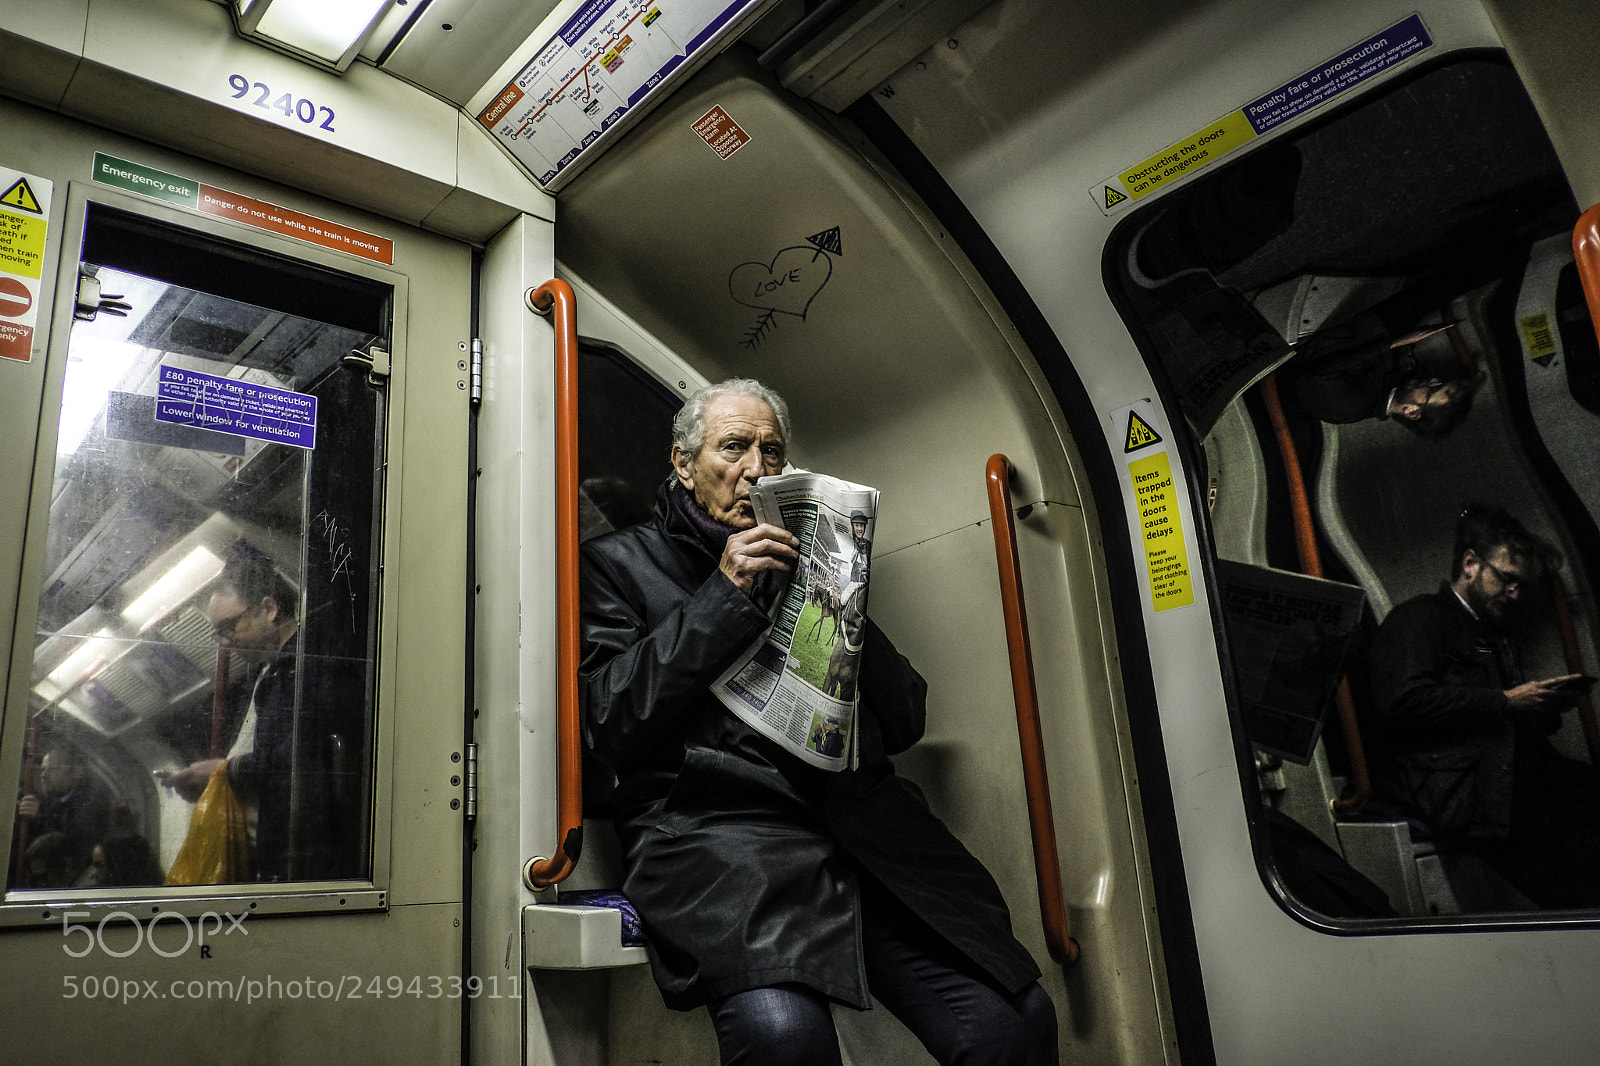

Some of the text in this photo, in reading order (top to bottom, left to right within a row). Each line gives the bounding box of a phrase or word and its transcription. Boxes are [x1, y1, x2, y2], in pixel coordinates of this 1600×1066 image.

[646, 77, 658, 88] Zone
[1248, 36, 1388, 118] Penalty fare or prosecution
[1261, 114, 1272, 123] you
[1272, 108, 1281, 116] fail
[1288, 96, 1304, 108] show
[1312, 80, 1334, 95] demand
[1359, 52, 1386, 70] validated
[1386, 35, 1417, 55] smartcard
[1266, 115, 1281, 126] other
[1281, 106, 1297, 118] travel
[1297, 92, 1324, 110] authority
[1323, 85, 1337, 96] valid
[1337, 80, 1347, 88] for
[1347, 74, 1358, 83] the
[1358, 64, 1376, 78] whole
[1385, 53, 1400, 64] your
[1400, 40, 1424, 56] journey
[228, 74, 336, 132] 92402
[485, 90, 516, 121] Central line
[606, 114, 616, 125] Zone
[695, 111, 718, 132] Passenger
[699, 114, 725, 137] Emergency
[583, 135, 593, 145] Zone
[704, 126, 719, 140] Alarm
[710, 130, 729, 148] Located
[716, 133, 737, 152] Opposite
[720, 138, 741, 157] Doorway
[561, 156, 571, 164] Zone
[1128, 128, 1225, 184] Obstructing the doors
[1134, 149, 1208, 192] can be dangerous
[102, 164, 190, 196] Emergency exit
[542, 174, 551, 183] Zone
[204, 195, 235, 210] Danger
[238, 206, 248, 214] do
[251, 210, 266, 218] not
[268, 215, 282, 224] use
[284, 219, 306, 230] while
[308, 226, 322, 235] the
[324, 230, 342, 241] train
[352, 239, 380, 253] moving
[18, 249, 38, 259] train
[754, 268, 801, 297] LOVE
[0, 325, 29, 336] gency
[165, 370, 184, 381] £80
[186, 375, 222, 391] penalty
[224, 382, 243, 394] fare
[258, 390, 311, 409] prosecution
[162, 406, 300, 438] Lower window for ventilation
[1136, 471, 1160, 484] Items
[1138, 478, 1172, 494] trapped
[1140, 493, 1165, 506] in the
[1142, 505, 1167, 518] doors
[1144, 516, 1168, 529] cause
[1146, 527, 1174, 540] delays
[1148, 549, 1166, 558] Please
[1150, 555, 1177, 566] keep your
[1152, 562, 1182, 574] belongings
[1164, 569, 1188, 580] clothing
[1166, 588, 1182, 597] doors
[200, 946, 212, 959] R
